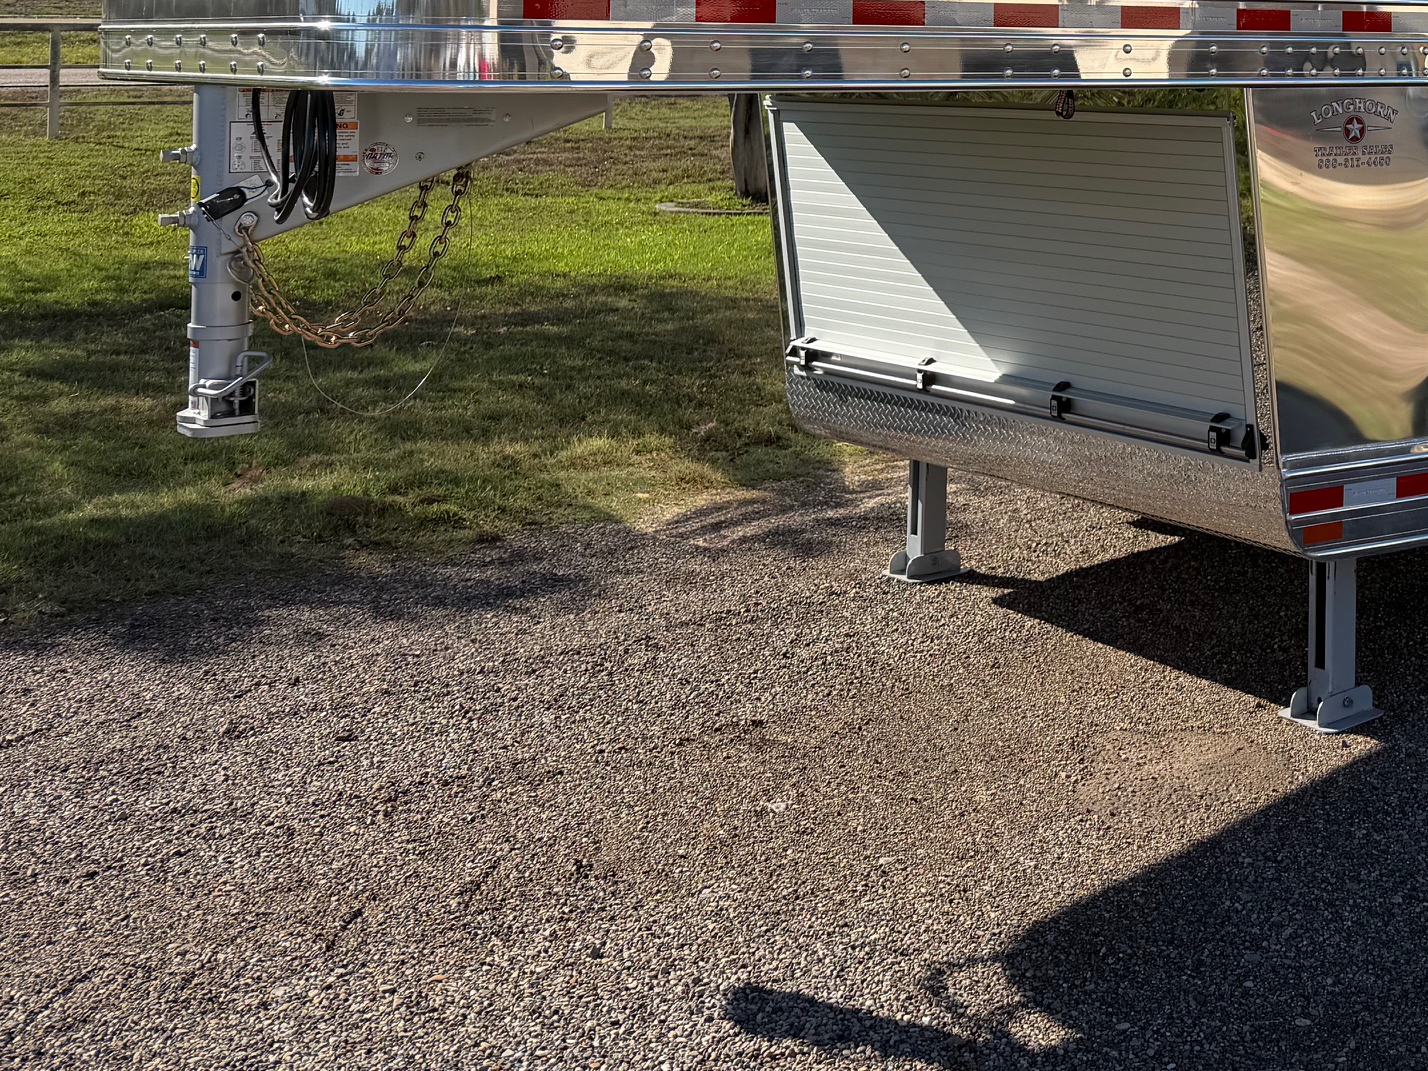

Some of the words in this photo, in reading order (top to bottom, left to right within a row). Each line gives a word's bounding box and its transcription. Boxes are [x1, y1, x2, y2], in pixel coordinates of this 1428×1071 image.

[1310, 98, 1399, 125] LONGHORN
[1314, 146, 1359, 157] TRAILER
[1362, 145, 1394, 156] SALES
